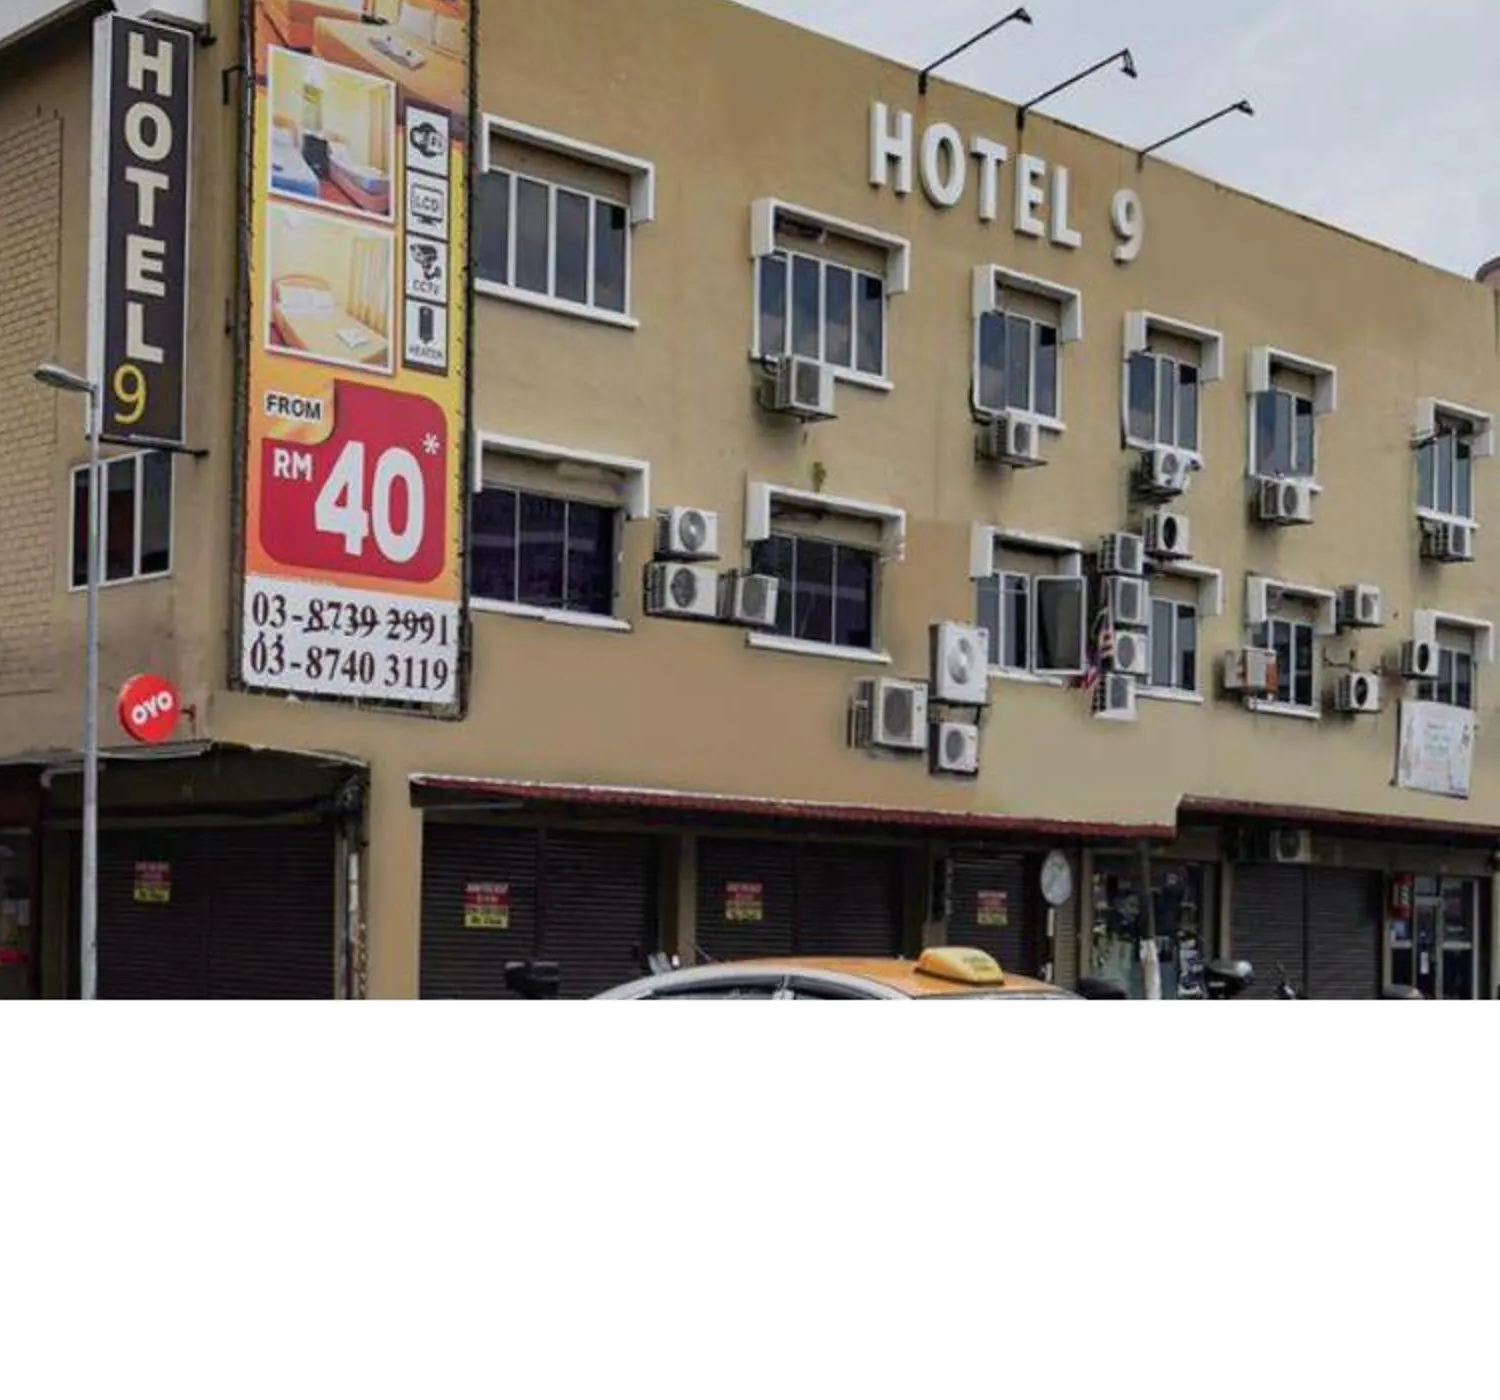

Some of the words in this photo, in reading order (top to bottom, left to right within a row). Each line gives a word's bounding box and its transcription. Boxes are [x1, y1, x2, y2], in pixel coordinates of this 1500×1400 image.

[124, 31, 174, 363] HOTEL
[869, 101, 1082, 250] HOTEL
[1111, 188, 1144, 263] 9
[113, 363, 147, 425] 9
[266, 393, 322, 422] FROM
[272, 448, 314, 482] RM
[384, 653, 449, 691] 3119
[131, 690, 174, 726] OYO
